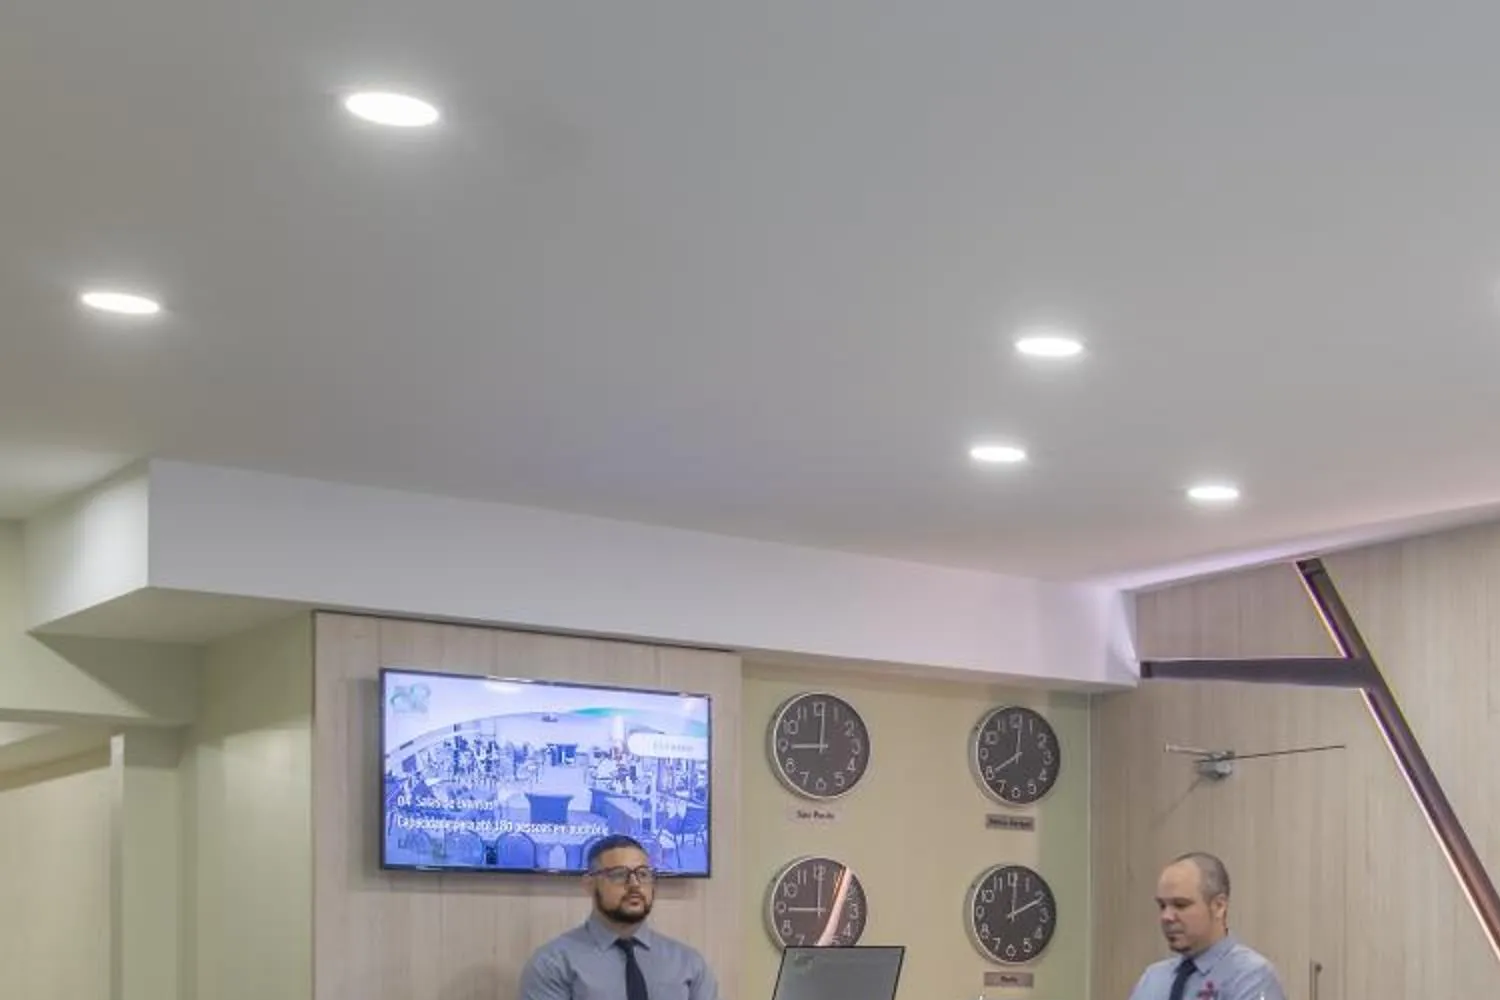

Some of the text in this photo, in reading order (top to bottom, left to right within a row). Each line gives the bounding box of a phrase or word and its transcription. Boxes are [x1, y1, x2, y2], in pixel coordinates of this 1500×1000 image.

[797, 706, 807, 721] 11
[783, 719, 799, 735] 10
[844, 720, 855, 737] 2
[997, 719, 1007, 733] 11
[778, 738, 789, 753] 9
[985, 730, 998, 745] 10
[1037, 732, 1047, 749] 2
[850, 738, 860, 755] 3
[785, 757, 795, 773] 8
[847, 757, 857, 771] 4
[1042, 749, 1053, 765] 3
[799, 770, 810, 786] 7
[834, 771, 845, 787] 5
[985, 765, 995, 780] 8
[1038, 768, 1048, 782] 4
[815, 777, 826, 791] 6
[996, 780, 1007, 793] 7
[1011, 785, 1021, 798] 6
[797, 869, 807, 886] 11
[993, 875, 1003, 892] 11
[783, 881, 798, 898] 10
[981, 888, 995, 903] 10
[775, 901, 787, 914] 9
[849, 902, 860, 920] 3
[975, 904, 985, 920] 9
[1039, 907, 1050, 923] 3
[782, 919, 794, 936] 8
[843, 921, 852, 937] 4
[980, 922, 990, 940] 8
[1033, 926, 1043, 939] 4
[992, 936, 1002, 952] 7
[1005, 943, 1017, 961] 6
[1023, 937, 1033, 953] 5
